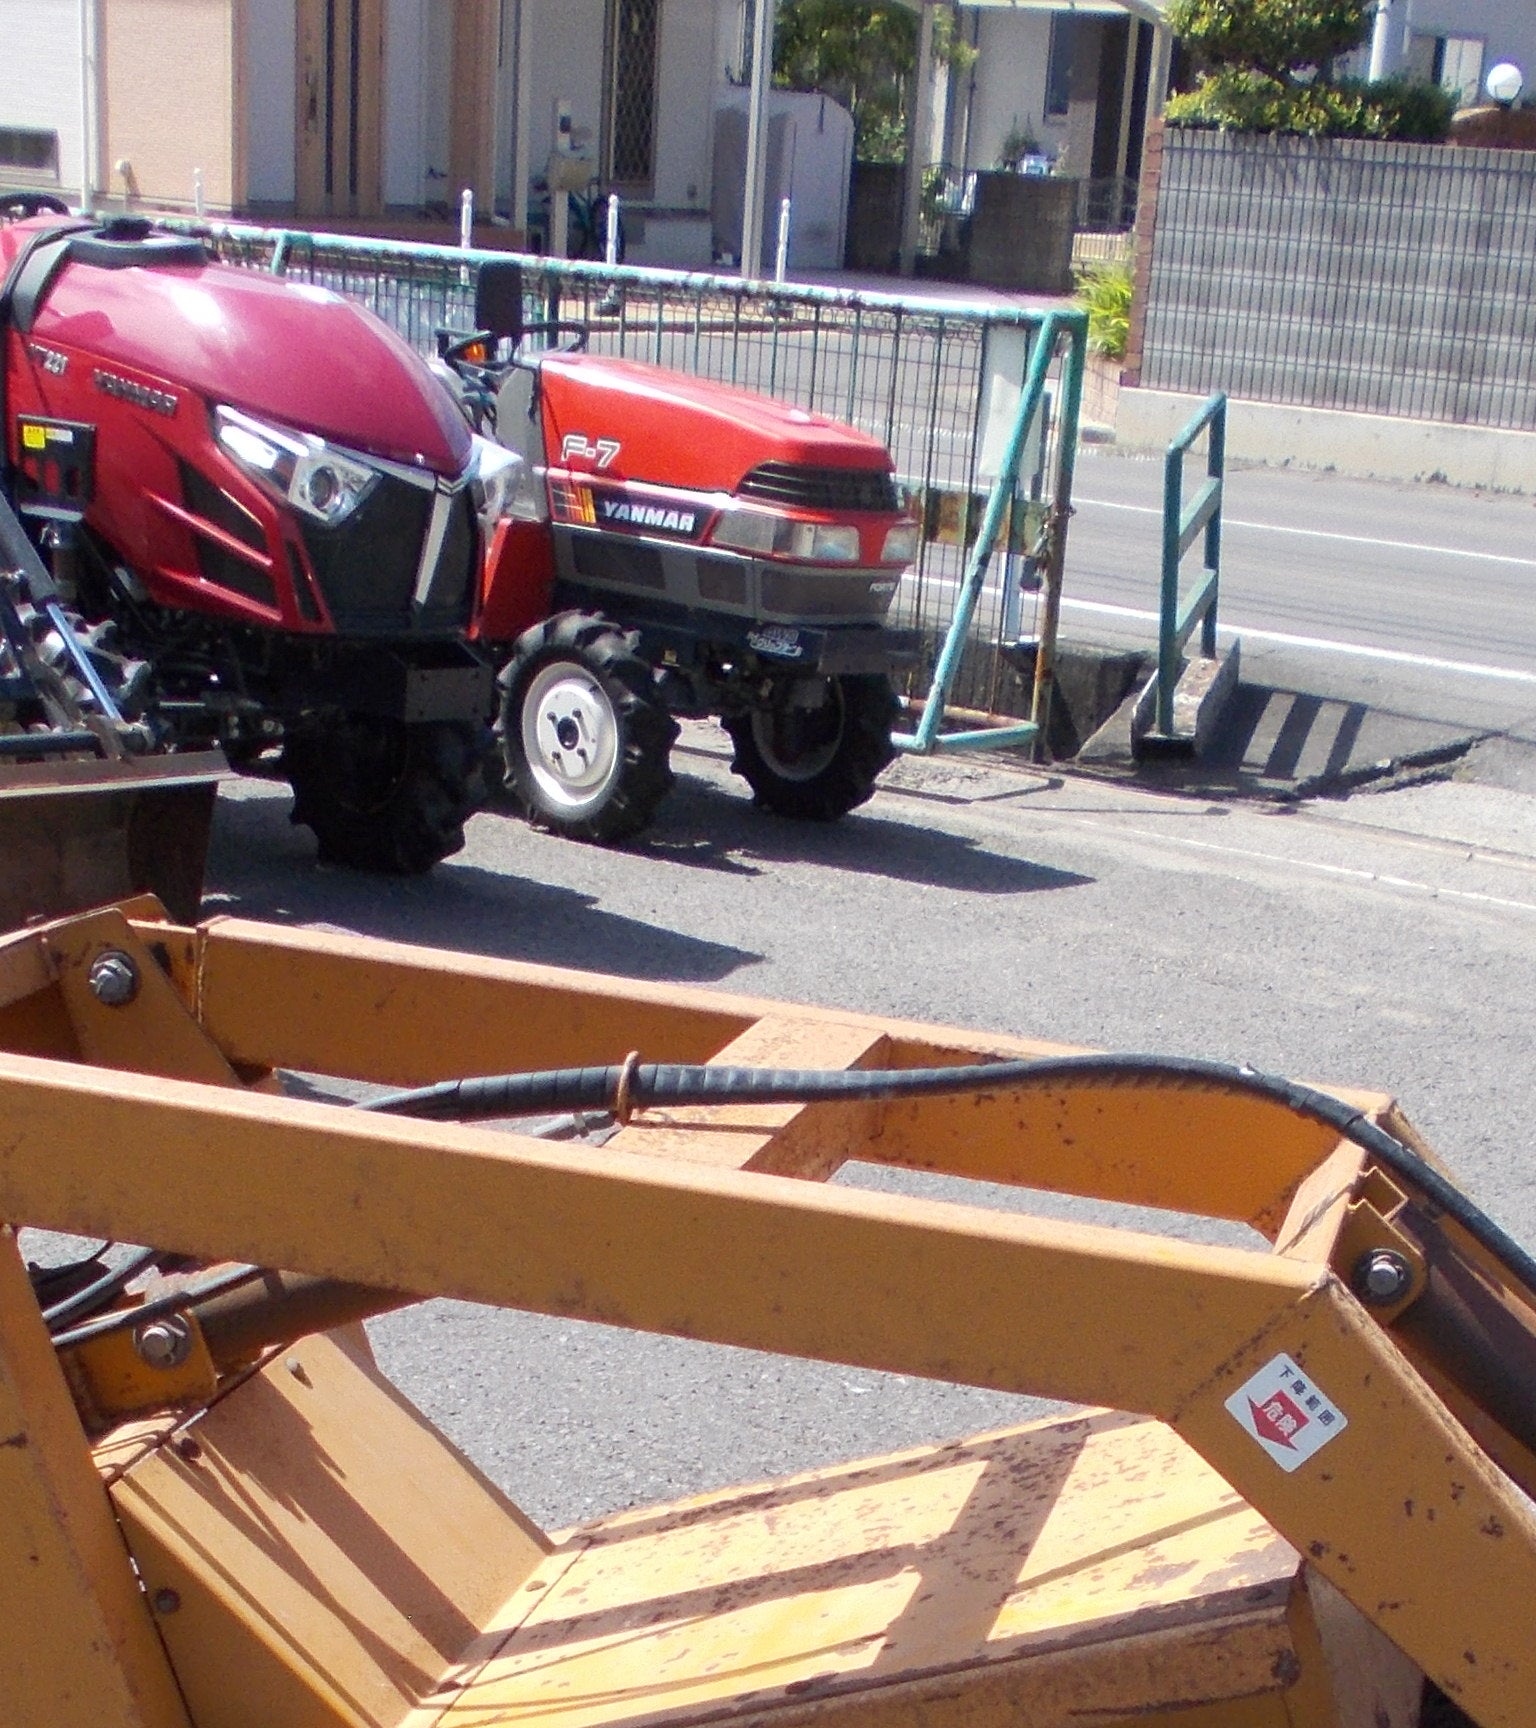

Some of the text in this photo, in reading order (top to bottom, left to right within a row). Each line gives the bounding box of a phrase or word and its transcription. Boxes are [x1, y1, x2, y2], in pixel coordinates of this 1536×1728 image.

[561, 431, 621, 468] F-7
[604, 500, 696, 532] YANMAR
[1279, 1364, 1336, 1427] 下降範囲
[1262, 1401, 1298, 1437] 危険
